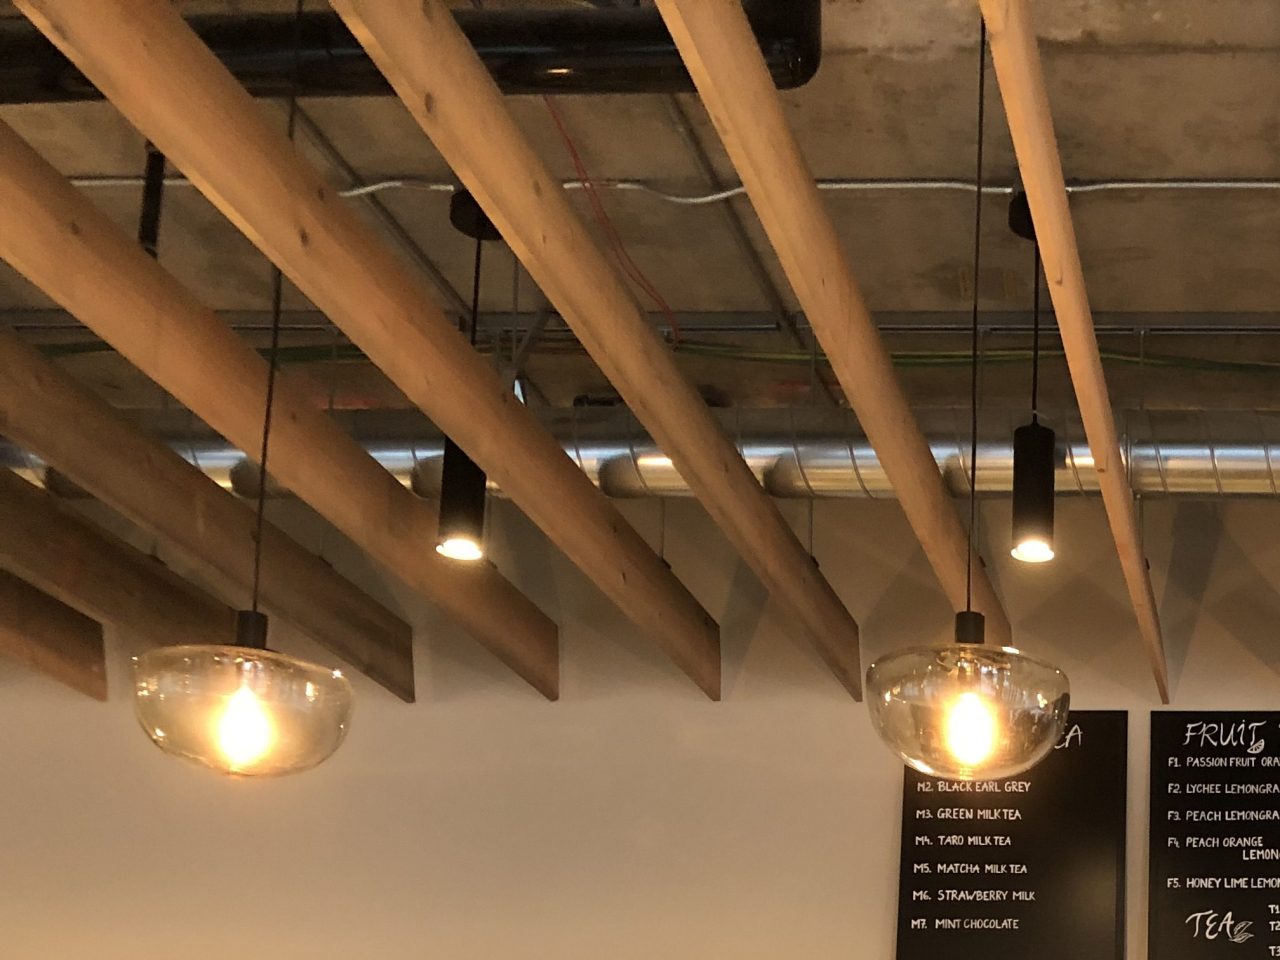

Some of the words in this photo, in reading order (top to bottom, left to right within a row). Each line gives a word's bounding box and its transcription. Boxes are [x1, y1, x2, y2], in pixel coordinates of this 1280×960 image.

[1169, 757, 1181, 767] F1.
[1187, 757, 1227, 767] PASSION
[1230, 757, 1256, 767] FRUIT
[918, 782, 933, 791] M2.
[937, 780, 973, 791] BLACK
[974, 780, 1001, 792] EARL
[1005, 781, 1031, 792] GREY
[1168, 783, 1181, 793] F2.
[1186, 784, 1221, 793] LYCHEE
[916, 809, 933, 818] M3.
[937, 808, 973, 819] GREEN
[977, 809, 1000, 819] MILK
[1002, 809, 1021, 820] TEA
[1168, 811, 1181, 820] F3.
[1186, 811, 1221, 821] PEACH
[916, 836, 933, 845] M4.
[938, 835, 964, 845] TARO
[968, 836, 994, 845] MILK
[993, 836, 1011, 845] TEA
[1186, 837, 1219, 847] PEACH
[1223, 837, 1263, 847] ORANGE
[914, 863, 931, 873] M5.
[938, 864, 979, 873] MATCHA
[985, 864, 1007, 873] MILK
[1009, 864, 1027, 873] TEA
[1167, 878, 1181, 888] F5.
[1187, 878, 1221, 888] HONEY
[1224, 878, 1248, 888] LIME
[913, 891, 931, 900] M6.
[938, 890, 1008, 901] STRAWBERRY
[1013, 891, 1035, 900] MILK
[912, 919, 927, 928] M7.
[935, 919, 961, 928] MINT
[964, 919, 1019, 929] CHOCOLATE
[1186, 910, 1236, 941] TEA
